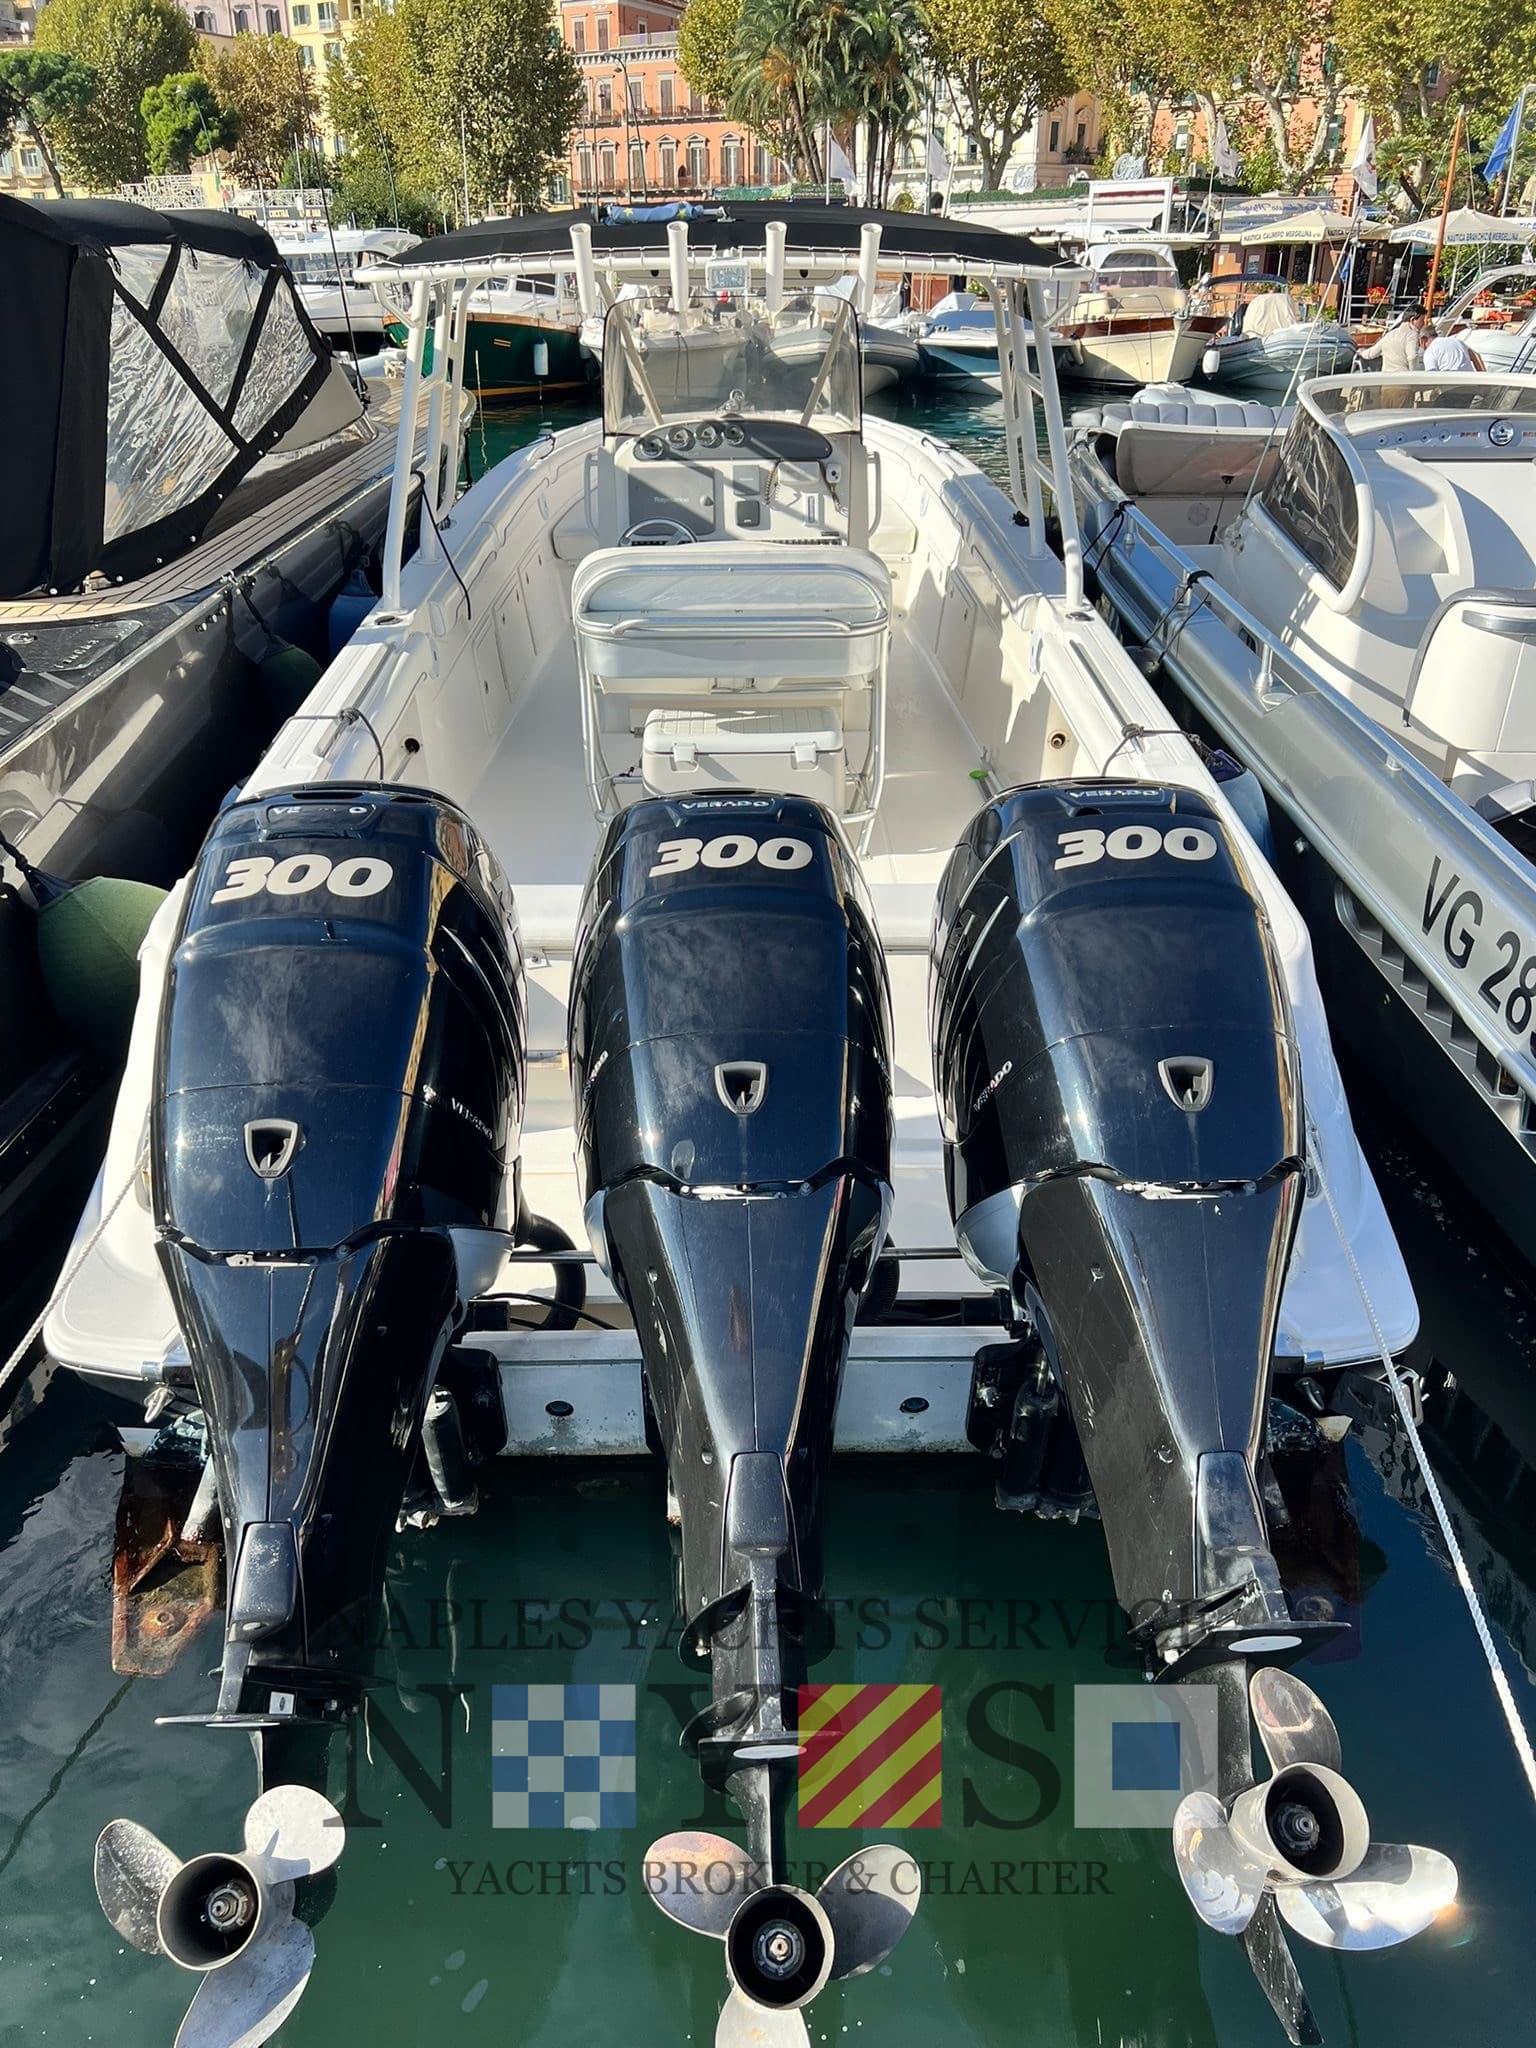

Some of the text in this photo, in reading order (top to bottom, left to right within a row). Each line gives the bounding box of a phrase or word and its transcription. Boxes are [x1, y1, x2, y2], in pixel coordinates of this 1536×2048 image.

[273, 806, 368, 815] VEO
[681, 800, 769, 810] VERADO
[1069, 789, 1160, 798] VERADO
[648, 834, 813, 879] 300
[1054, 825, 1218, 871] 300
[210, 853, 394, 905] 300
[1421, 855, 1483, 969] VG
